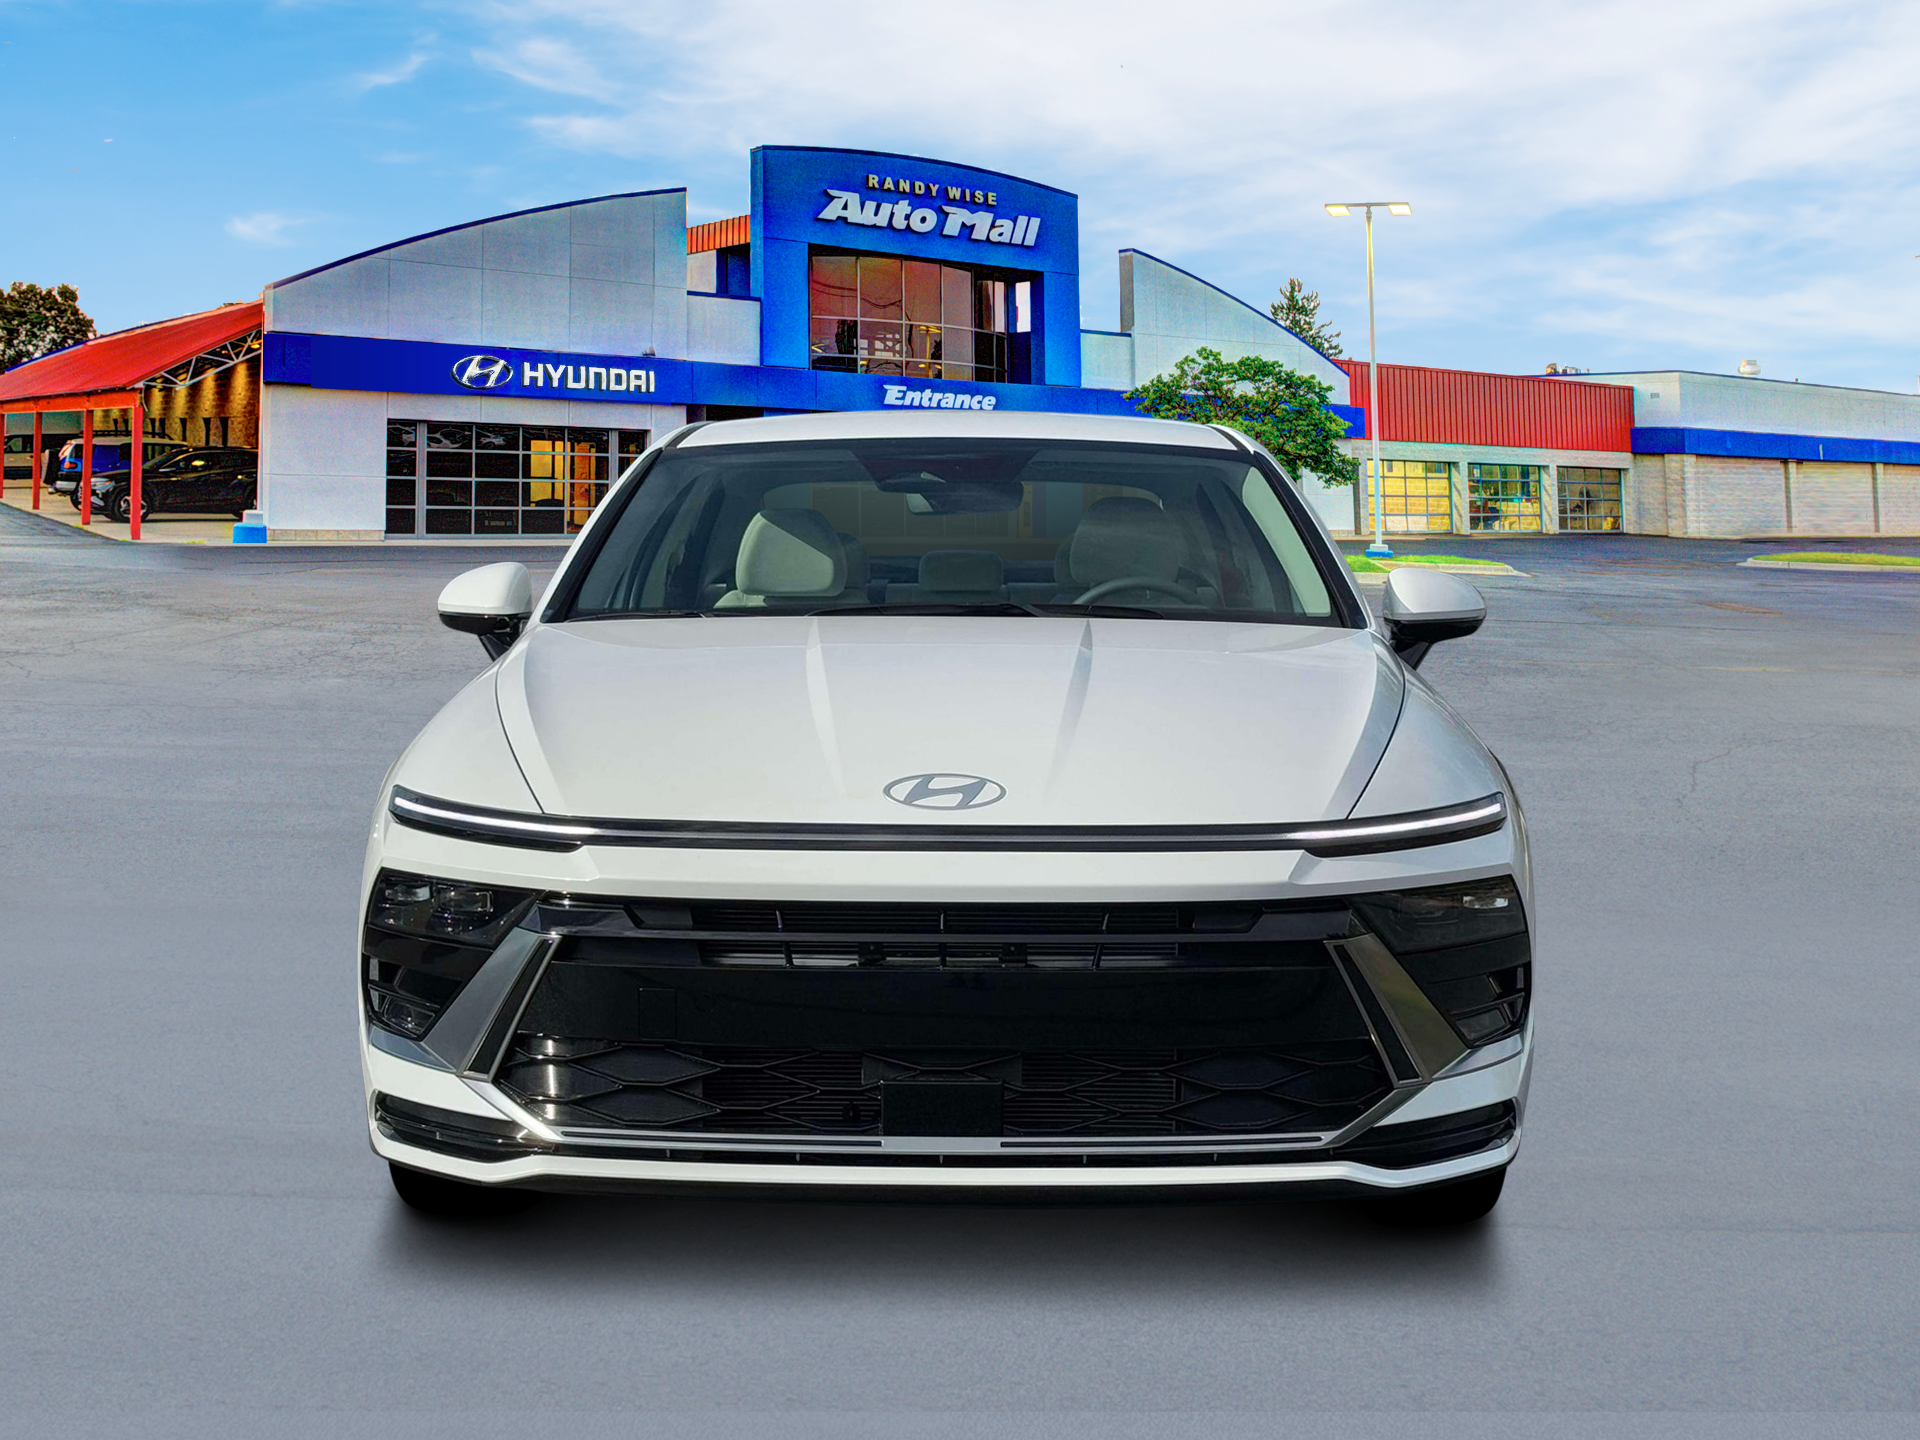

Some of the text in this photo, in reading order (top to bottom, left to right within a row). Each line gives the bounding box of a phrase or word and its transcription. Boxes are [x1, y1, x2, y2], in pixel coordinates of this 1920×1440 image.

[867, 174, 997, 205] RANDY WISE
[817, 189, 1041, 246] Auto Mall
[522, 361, 656, 393] HYUNDAI
[883, 385, 996, 411] Entrance
